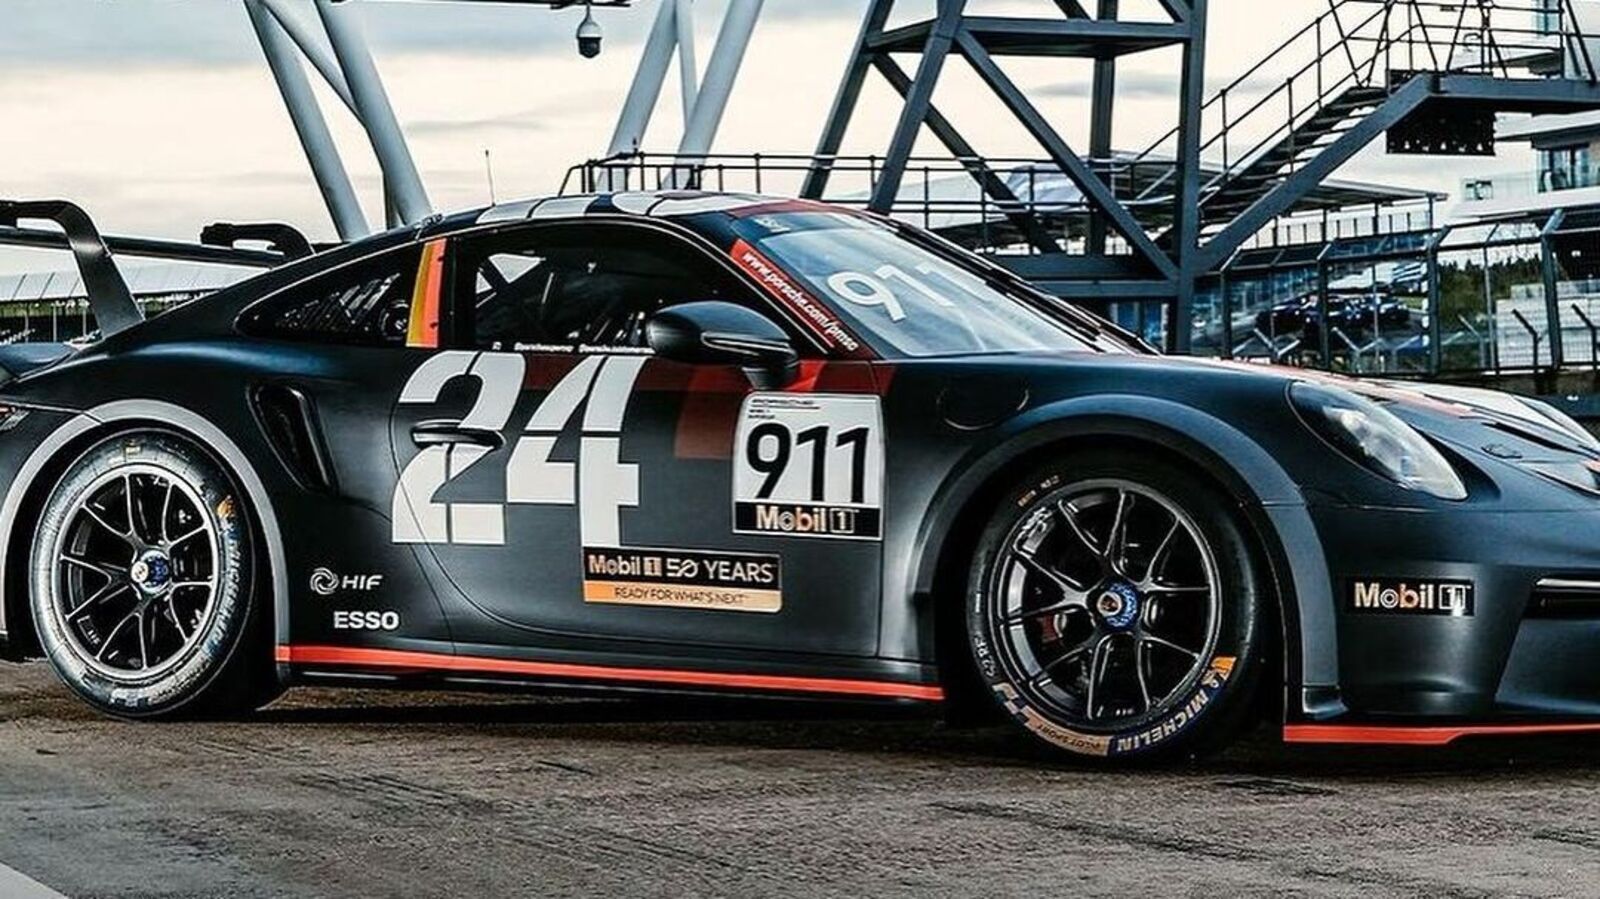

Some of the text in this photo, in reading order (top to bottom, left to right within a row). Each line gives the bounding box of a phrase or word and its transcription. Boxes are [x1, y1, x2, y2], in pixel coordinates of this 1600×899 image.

[392, 350, 649, 547] 24
[746, 422, 869, 503] 911
[756, 505, 826, 532] Mobil
[342, 575, 383, 590] HIF
[588, 555, 640, 576] Mobil
[667, 558, 699, 578] 50
[703, 560, 774, 583] YEARS
[614, 587, 649, 599] READY
[651, 588, 673, 601] FOR
[715, 593, 745, 604] NEXT
[1354, 582, 1434, 609] Mobil
[333, 611, 399, 630] ESSO
[1116, 688, 1209, 752] MICHELIN
